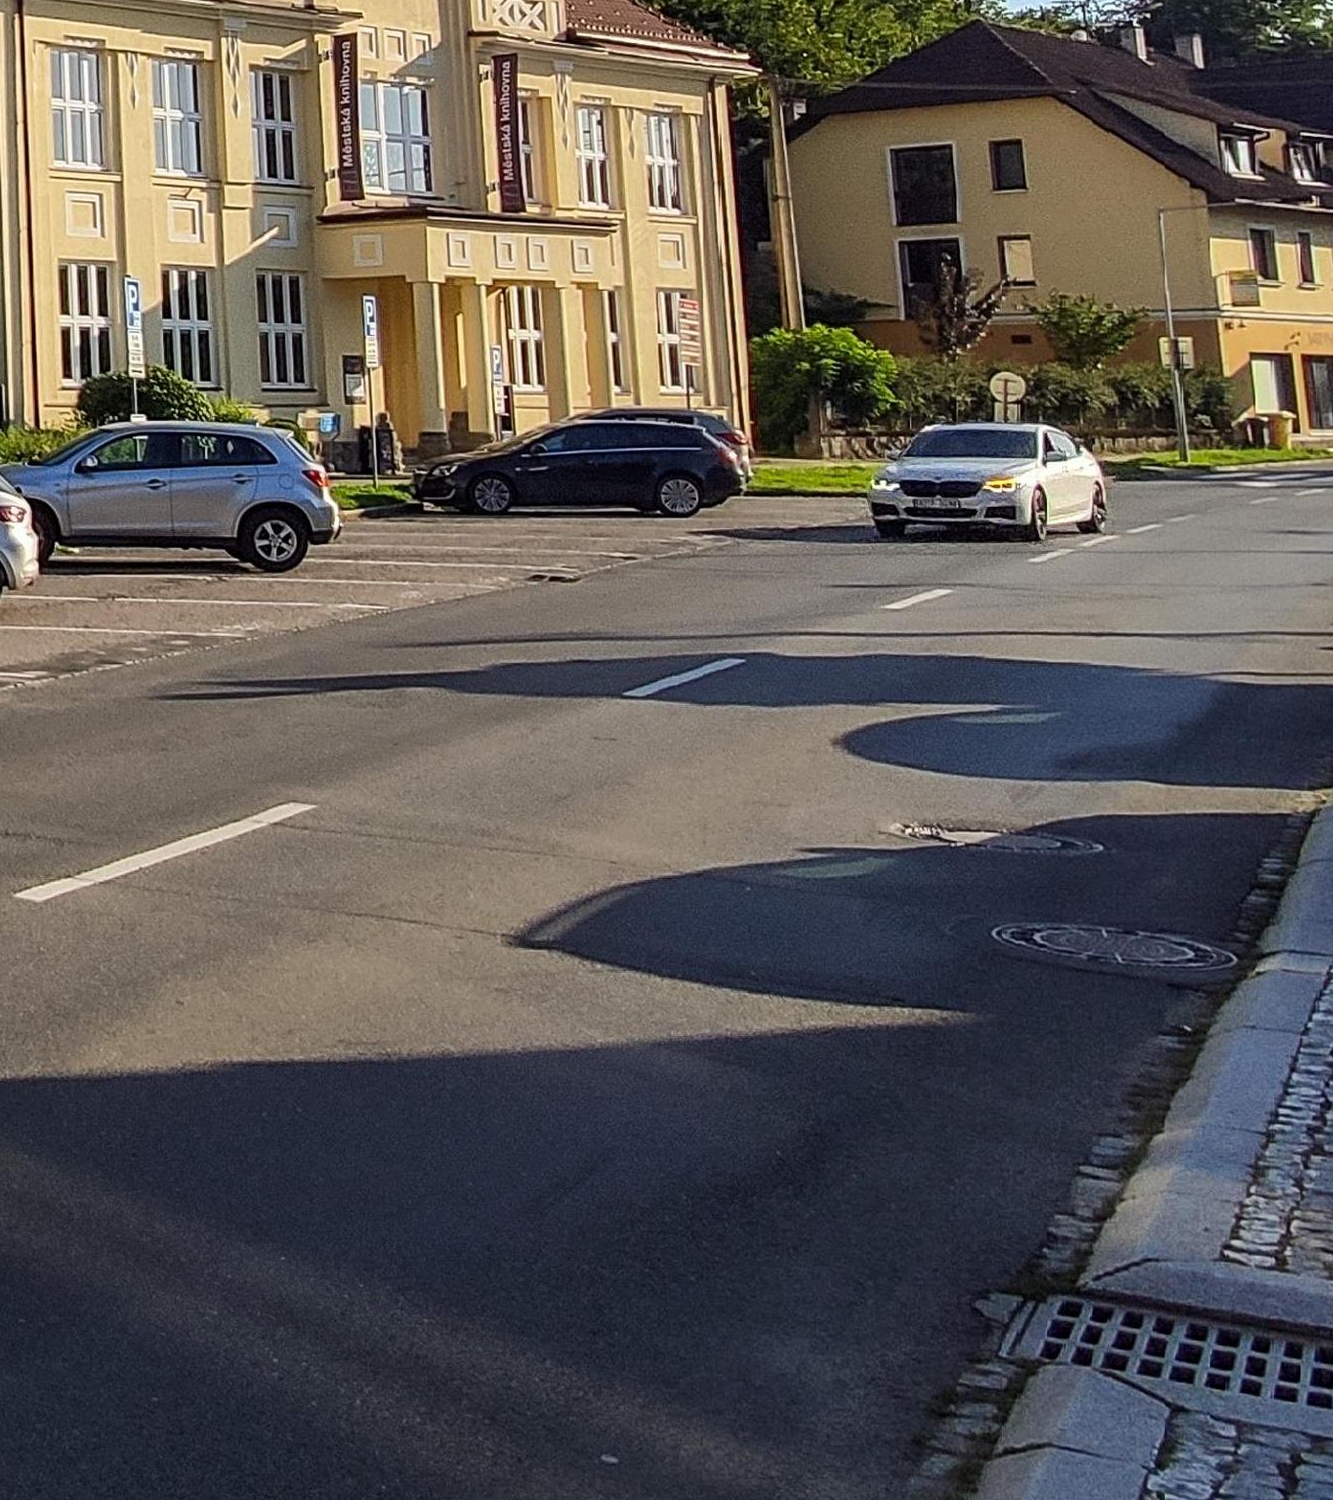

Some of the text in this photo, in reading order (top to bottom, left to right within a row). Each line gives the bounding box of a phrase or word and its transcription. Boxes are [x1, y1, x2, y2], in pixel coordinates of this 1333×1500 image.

[340, 41, 353, 168] Městská knihovna
[499, 61, 514, 181] Městská knihovna
[128, 284, 137, 313] P
[365, 301, 374, 325] P
[493, 350, 500, 373] P
